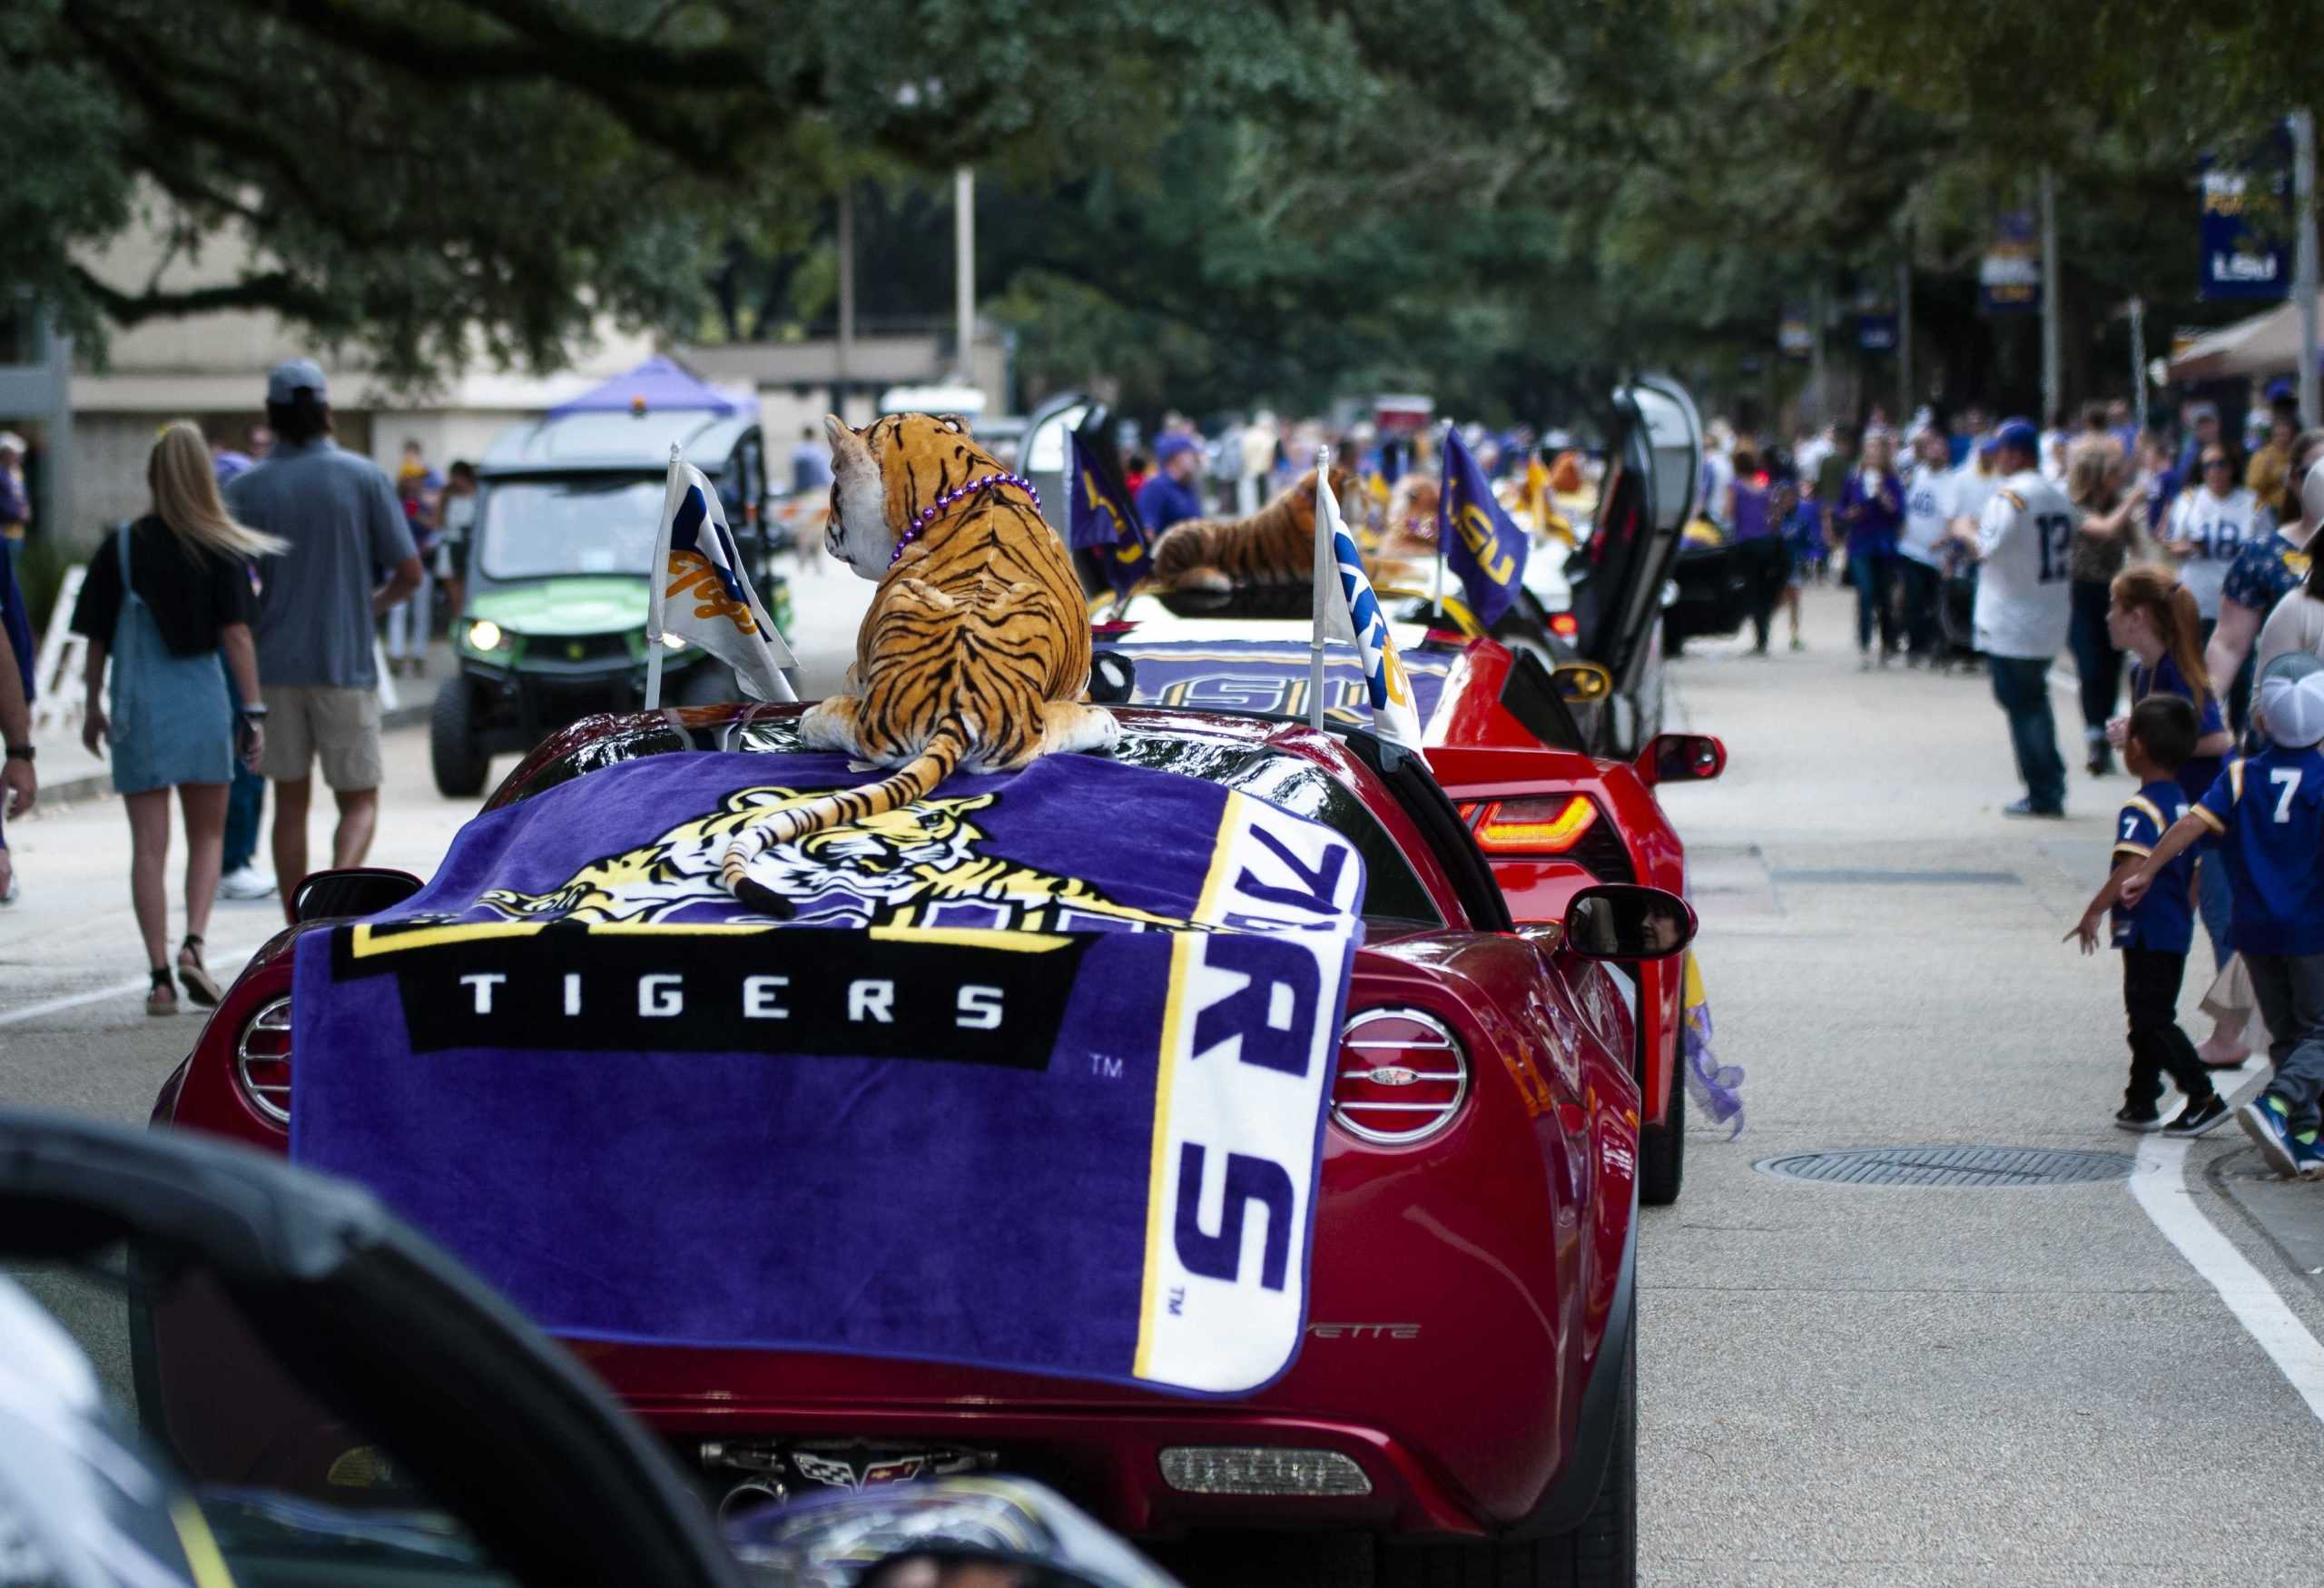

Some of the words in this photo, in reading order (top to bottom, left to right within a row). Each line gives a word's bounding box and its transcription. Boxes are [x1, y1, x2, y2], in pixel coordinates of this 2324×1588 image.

[2270, 768, 2303, 824] 7
[2122, 817, 2139, 839] 7
[459, 972, 1004, 1030] TIGERS
[1089, 1052, 1123, 1079] TM
